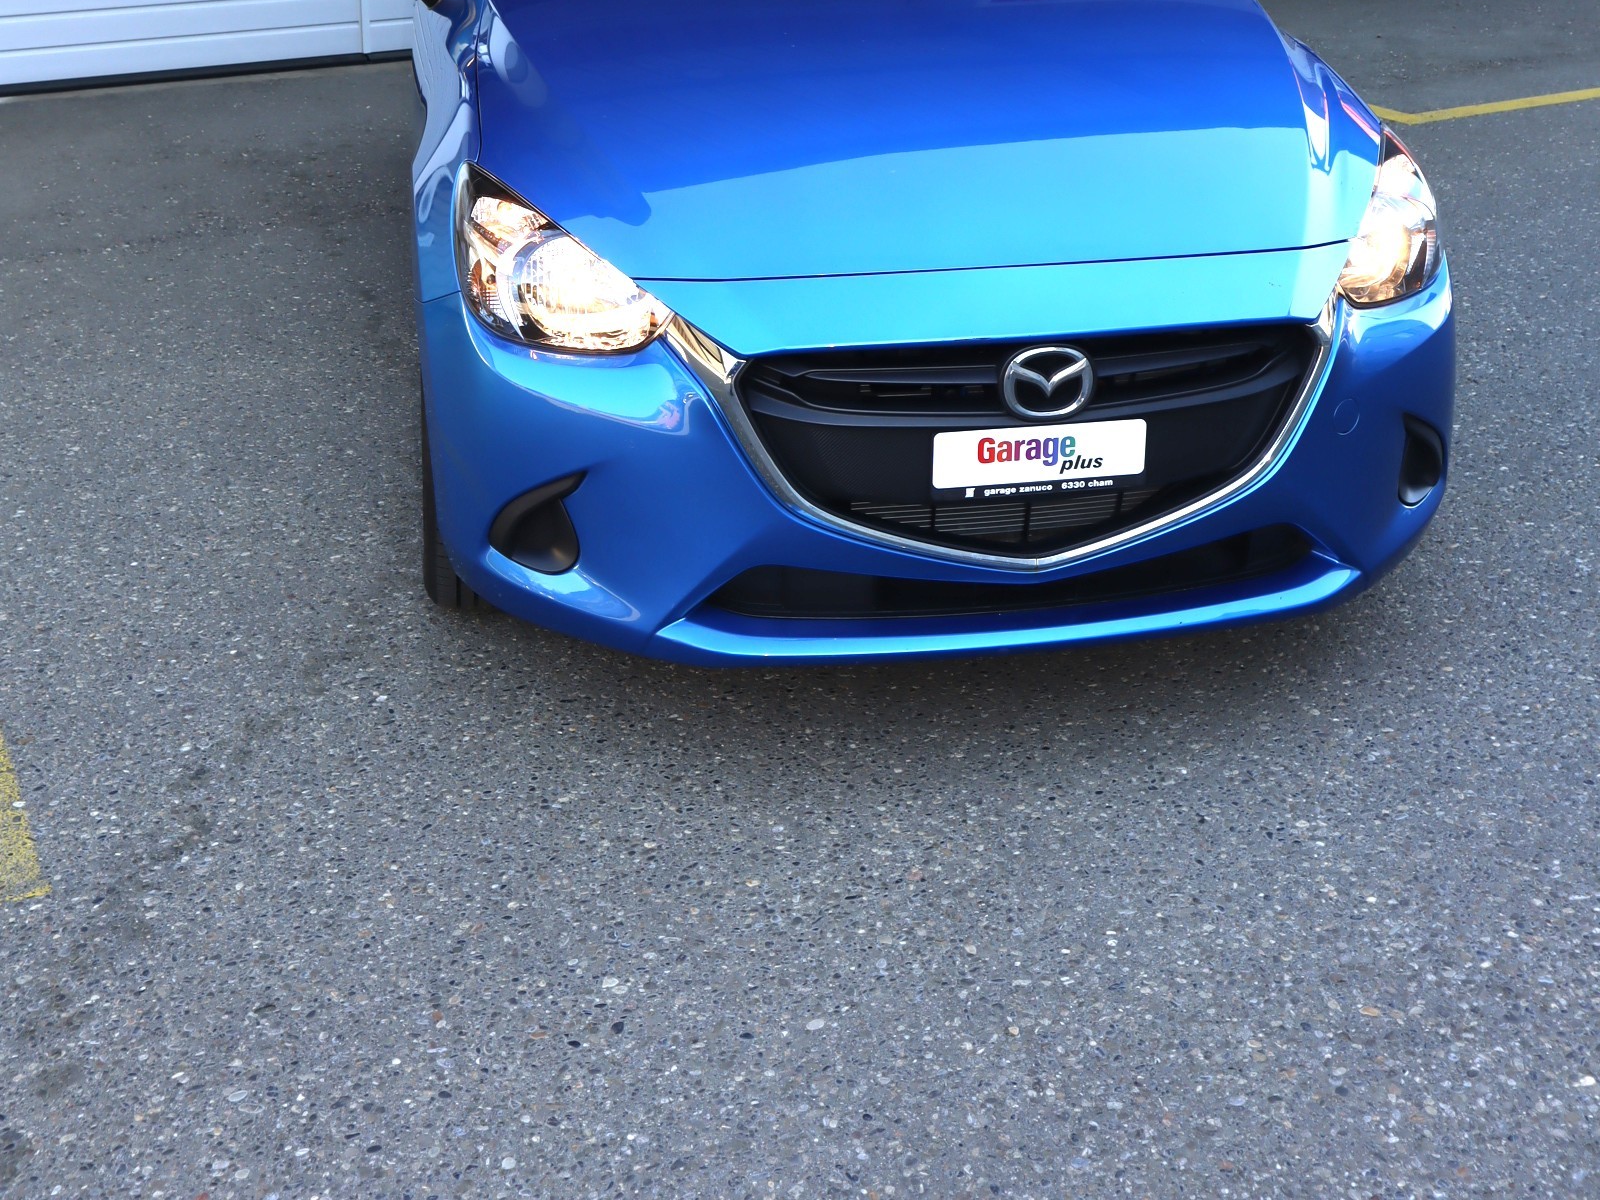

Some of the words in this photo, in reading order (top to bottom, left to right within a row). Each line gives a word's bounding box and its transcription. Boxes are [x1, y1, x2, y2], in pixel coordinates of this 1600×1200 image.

[977, 436, 1076, 467] Garage
[1059, 455, 1104, 475] plus
[983, 488, 1017, 497] garage
[1018, 484, 1053, 493] zanuco
[1061, 481, 1086, 490] 6330
[1087, 479, 1114, 488] cham
